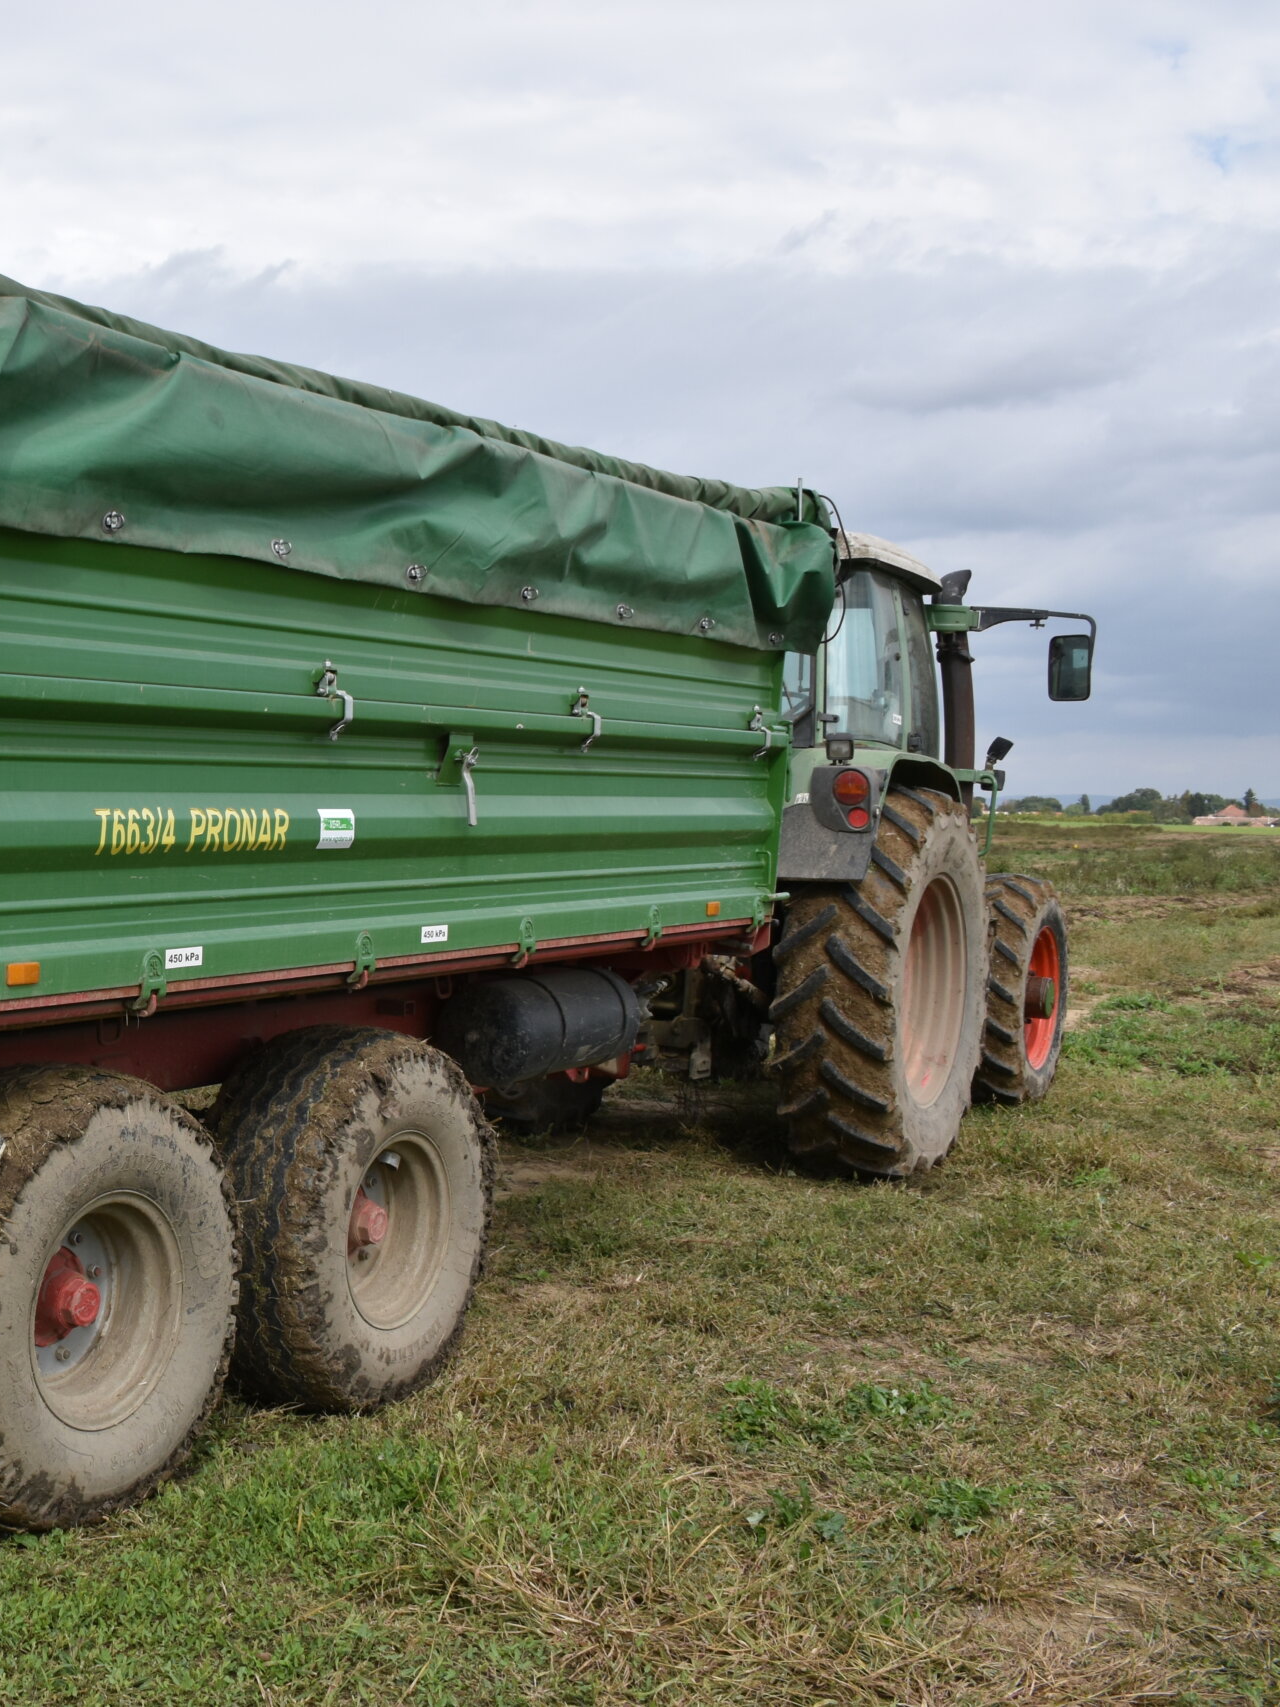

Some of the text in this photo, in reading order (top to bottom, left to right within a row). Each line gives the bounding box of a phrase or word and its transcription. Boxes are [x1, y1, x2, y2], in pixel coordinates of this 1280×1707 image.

[94, 807, 290, 856] T663/4 PRONAR
[168, 952, 200, 964] 450 kPa
